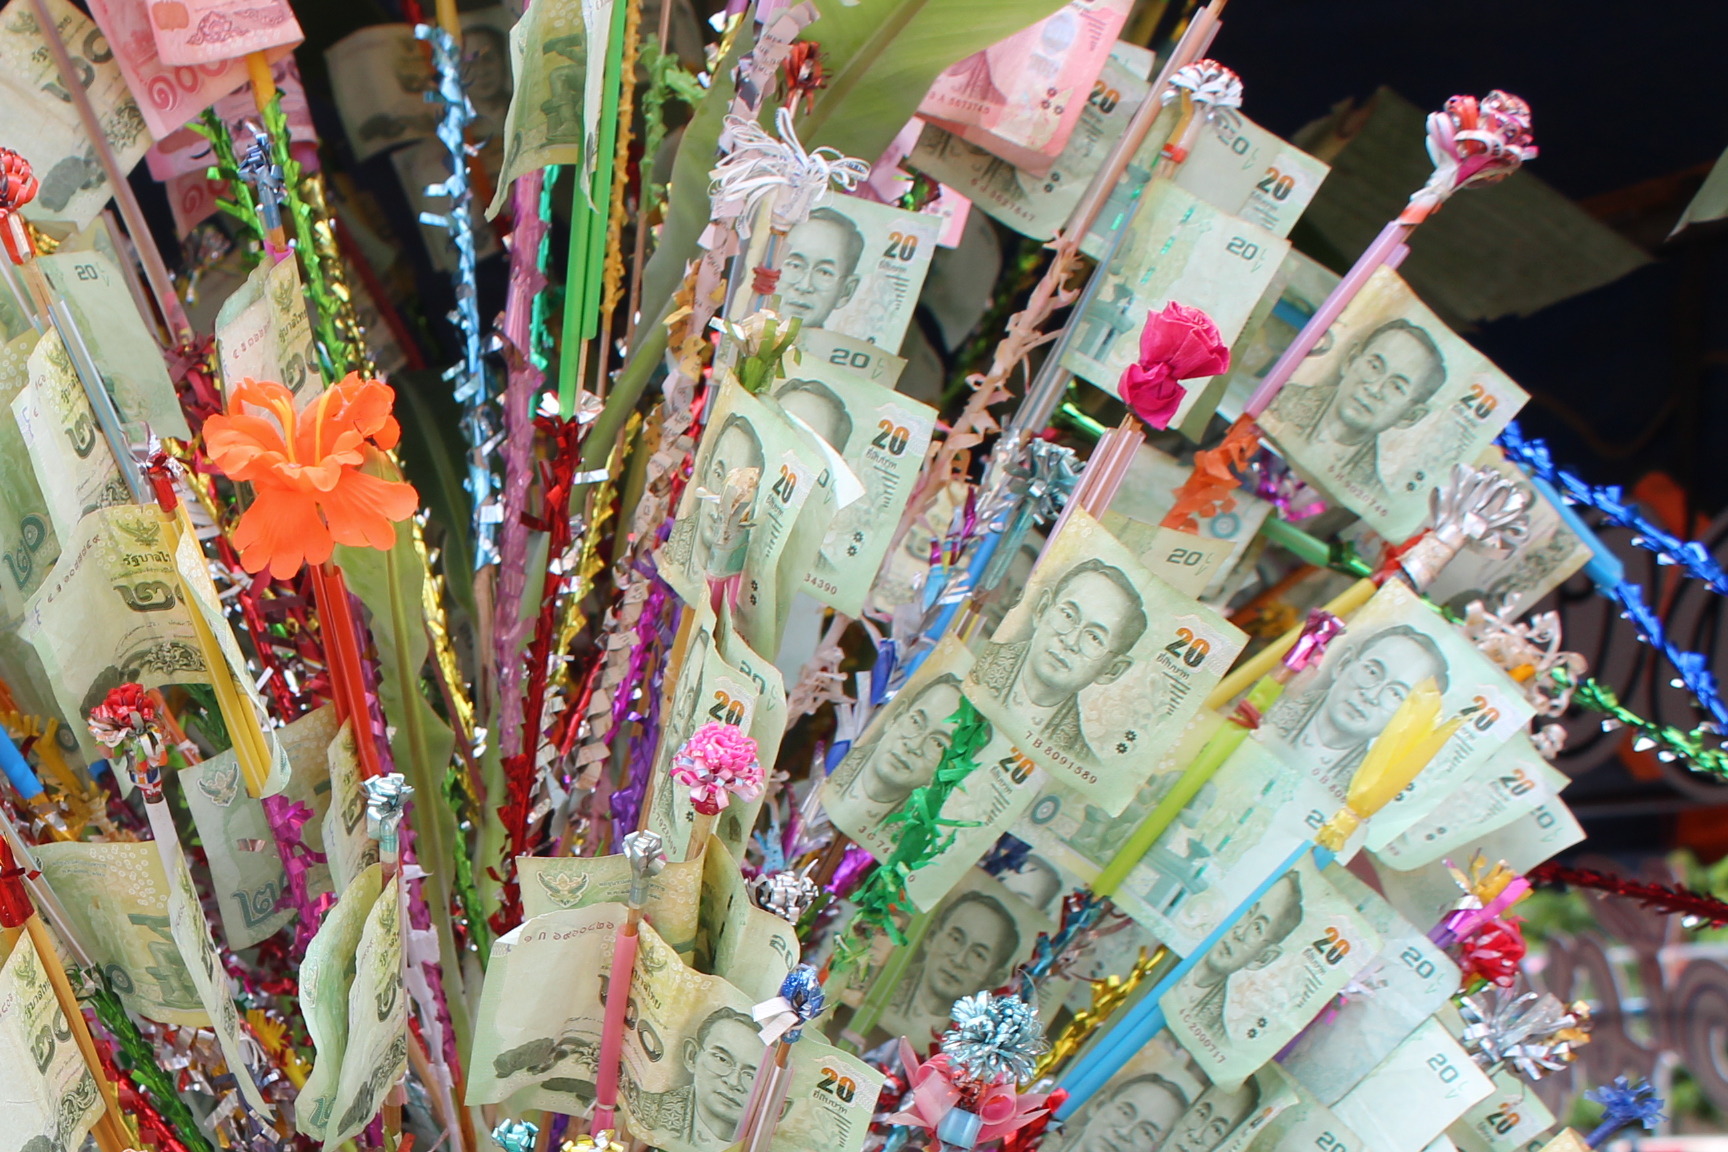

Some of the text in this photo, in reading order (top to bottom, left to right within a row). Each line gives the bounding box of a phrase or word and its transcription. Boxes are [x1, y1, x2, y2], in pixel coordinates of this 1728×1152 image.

[1087, 80, 1122, 113] 20
[1255, 166, 1297, 201] 20
[883, 230, 919, 263] 20
[1225, 235, 1260, 261] 20
[74, 264, 100, 281] 20
[828, 347, 870, 369] 20
[1468, 382, 1498, 421] 20
[872, 417, 910, 458] 20
[772, 462, 798, 505] 20
[3, 512, 49, 590] ๒๐
[122, 548, 171, 568] รัฐบาลไ
[1167, 548, 1205, 568] 20
[1164, 626, 1210, 668] 20
[714, 688, 745, 727] 20
[1460, 695, 1501, 732] 20
[998, 746, 1034, 785] 20
[1501, 768, 1536, 798] 20
[770, 933, 795, 972] 20
[1312, 926, 1351, 960] 20
[1401, 945, 1435, 979] 20
[814, 1067, 857, 1101] 20
[1426, 1052, 1462, 1085] 20
[1488, 1101, 1520, 1138] 20
